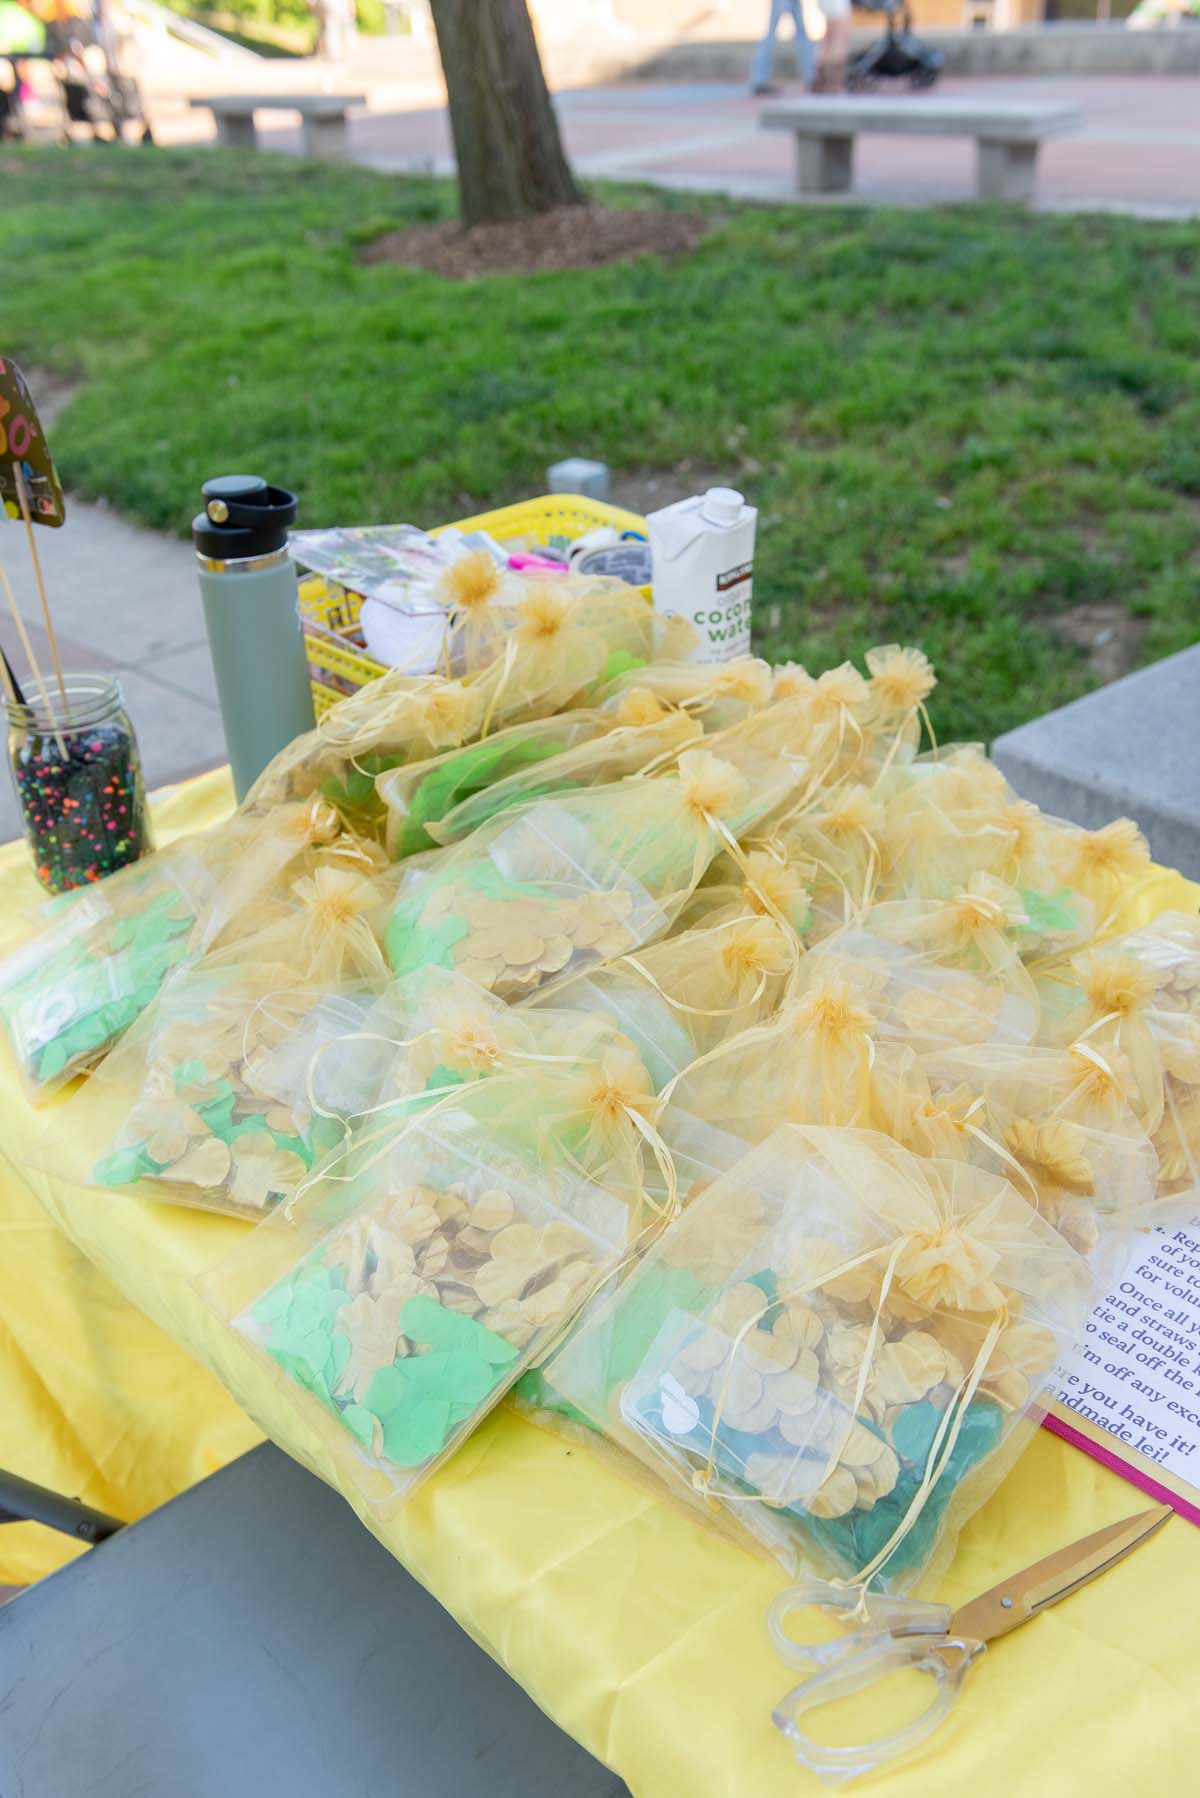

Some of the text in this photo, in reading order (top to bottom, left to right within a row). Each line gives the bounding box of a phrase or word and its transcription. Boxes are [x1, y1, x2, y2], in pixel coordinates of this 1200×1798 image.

[1148, 1255, 1184, 1278] sure
[1160, 1244, 1200, 1270] of yo
[1119, 1282, 1163, 1311] Once
[1163, 1308, 1190, 1326] all
[1135, 1264, 1200, 1308] for volu
[1093, 1306, 1190, 1367] tie a double
[1105, 1295, 1197, 1351] and straws
[1098, 1331, 1136, 1354] seal
[1135, 1353, 1167, 1371] off
[1163, 1368, 1194, 1390] the
[1043, 1383, 1170, 1463] andmade lei!
[1078, 1383, 1118, 1410] you
[1118, 1404, 1168, 1440] have
[1169, 1435, 1197, 1456] it!
[1103, 1363, 1135, 1381] off
[1130, 1379, 1167, 1403] any
[1166, 1401, 1200, 1428] exc
